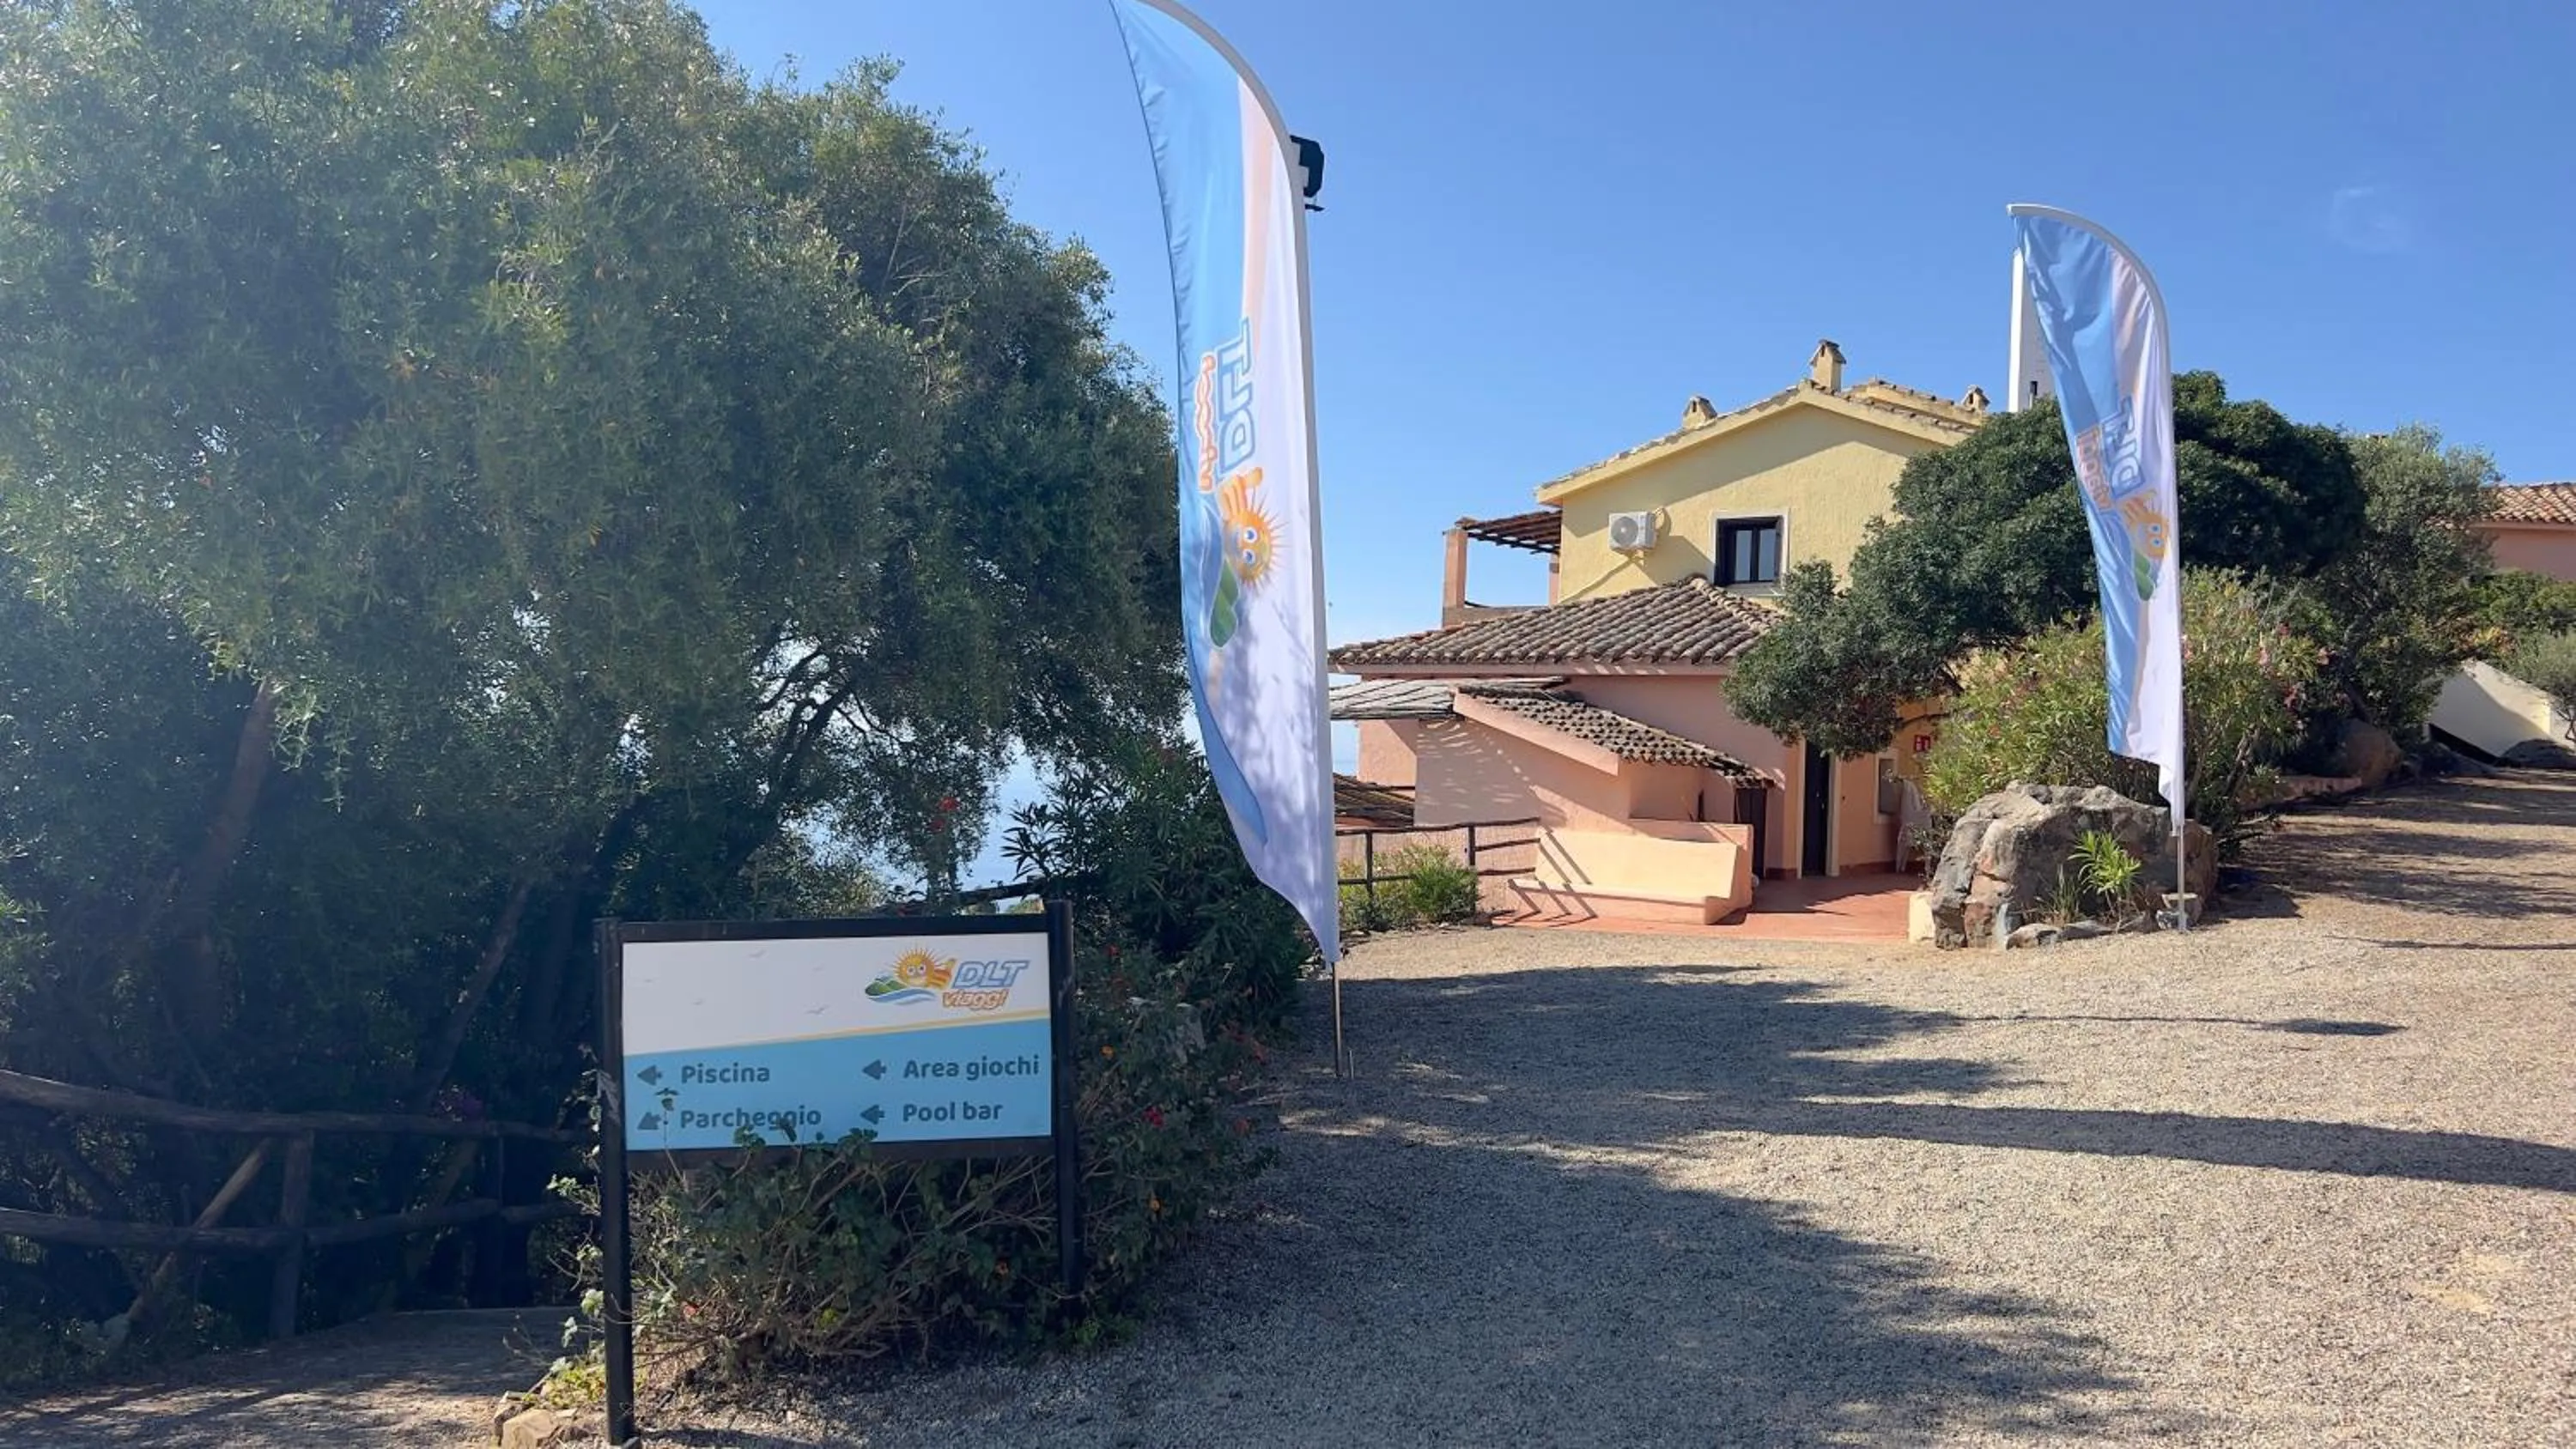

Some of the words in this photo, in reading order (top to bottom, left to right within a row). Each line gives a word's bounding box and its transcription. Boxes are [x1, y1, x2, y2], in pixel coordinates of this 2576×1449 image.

[952, 960, 1030, 988] DLT
[681, 1062, 771, 1084] Piscina
[902, 1059, 960, 1079] Area
[966, 1054, 1040, 1081] giochi
[902, 1101, 957, 1122] Pool
[963, 1101, 1004, 1120] bar
